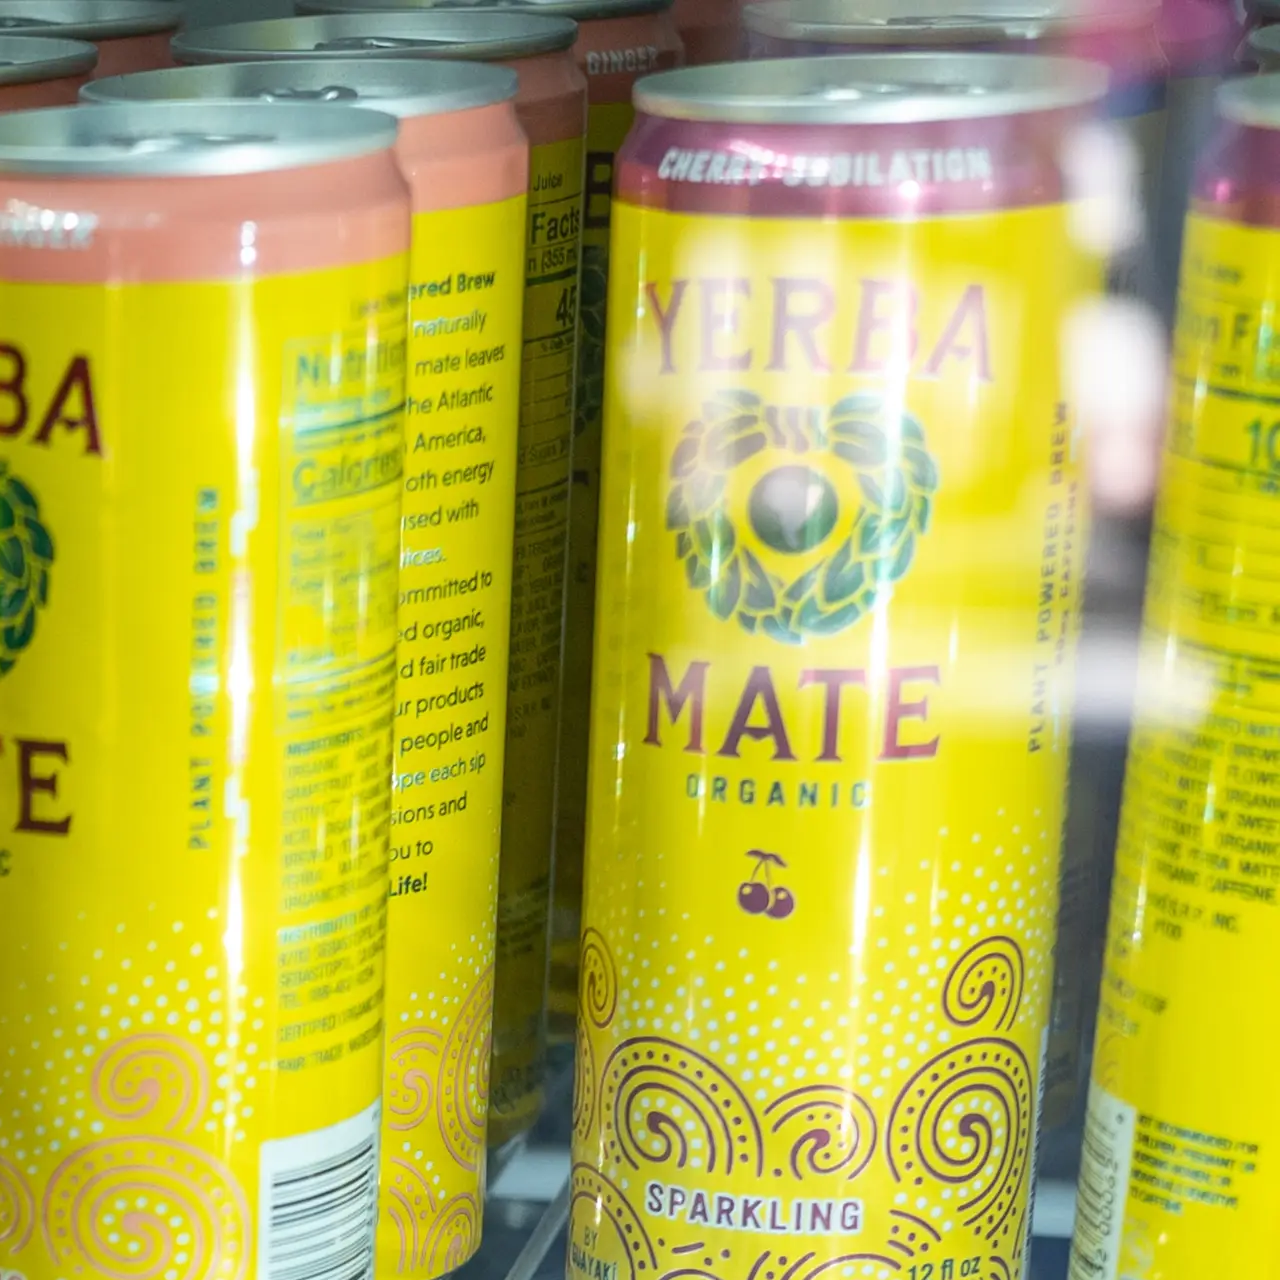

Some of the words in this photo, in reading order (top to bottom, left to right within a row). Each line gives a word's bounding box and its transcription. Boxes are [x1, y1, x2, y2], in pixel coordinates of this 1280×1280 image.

[456, 271, 496, 293] Brew
[413, 310, 488, 338] naturally
[645, 277, 994, 384] YERBA
[415, 355, 461, 377] mate
[465, 344, 505, 368] leaves
[437, 383, 494, 412] Atlantic
[413, 426, 486, 451] America,
[442, 461, 495, 487] energy
[446, 499, 479, 523] with
[423, 609, 485, 643] organic,
[419, 654, 447, 677] fair
[449, 645, 486, 670] trade
[416, 680, 485, 718] products
[643, 652, 941, 763] MATE
[400, 723, 463, 756] people
[466, 713, 488, 737] and
[430, 761, 466, 783] each
[470, 752, 486, 775] sip
[439, 792, 467, 817] and
[687, 772, 873, 809] ORGANIC
[390, 872, 428, 897] Life!
[646, 1182, 863, 1235] SPARKLING
[958, 1256, 982, 1280] oz
